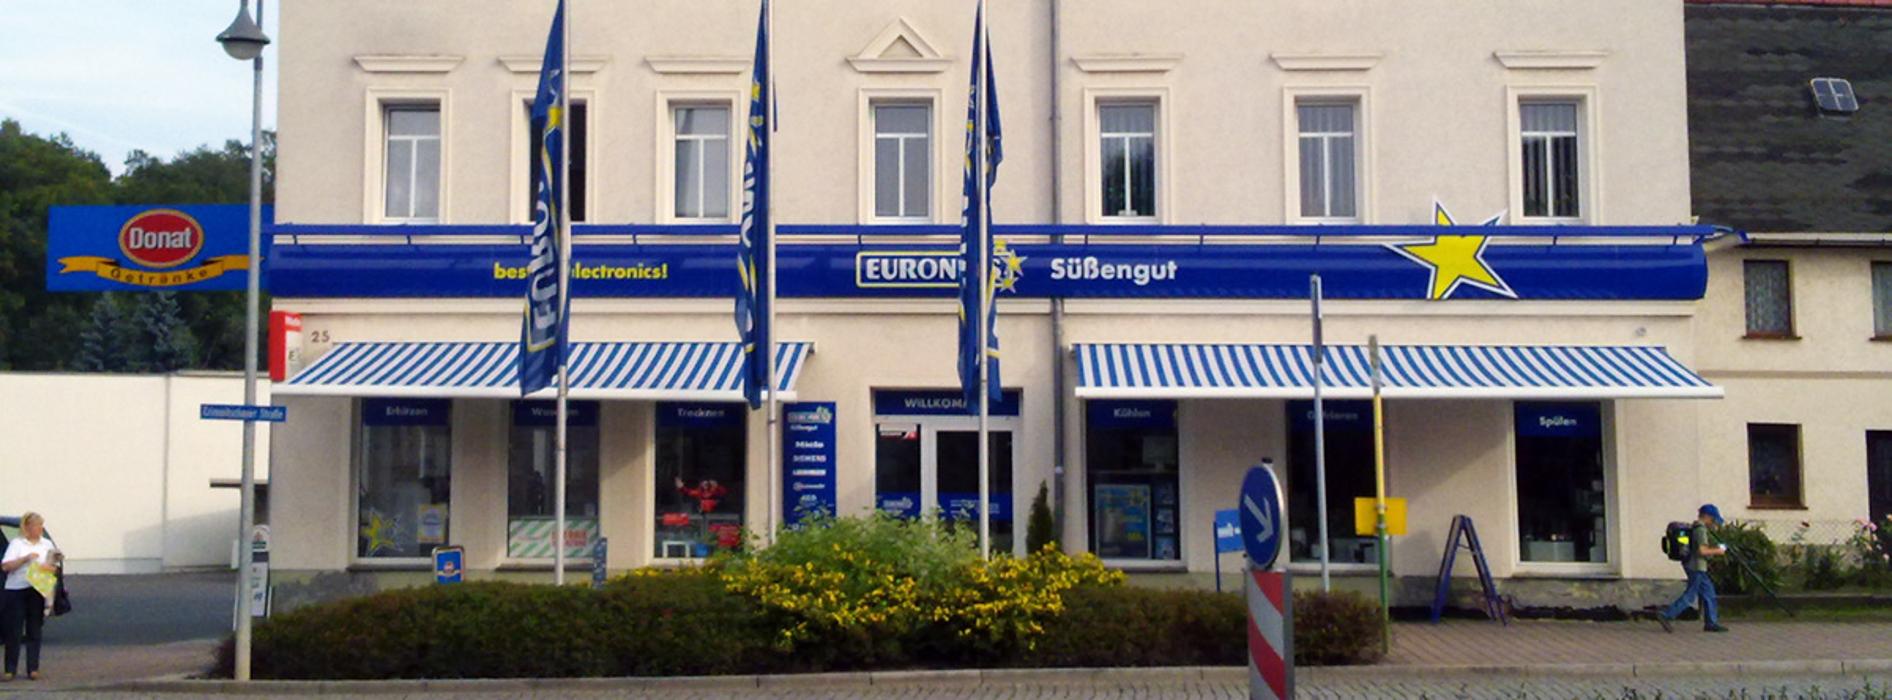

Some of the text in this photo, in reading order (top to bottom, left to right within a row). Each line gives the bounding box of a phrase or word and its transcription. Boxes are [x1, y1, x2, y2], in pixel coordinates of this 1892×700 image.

[128, 226, 193, 250] Donat
[493, 260, 669, 280] bes lectronics!
[1050, 256, 1178, 285] Süßengut
[311, 329, 331, 343] 25
[904, 397, 968, 409] WILLKOM
[1539, 415, 1577, 429] Spülen
